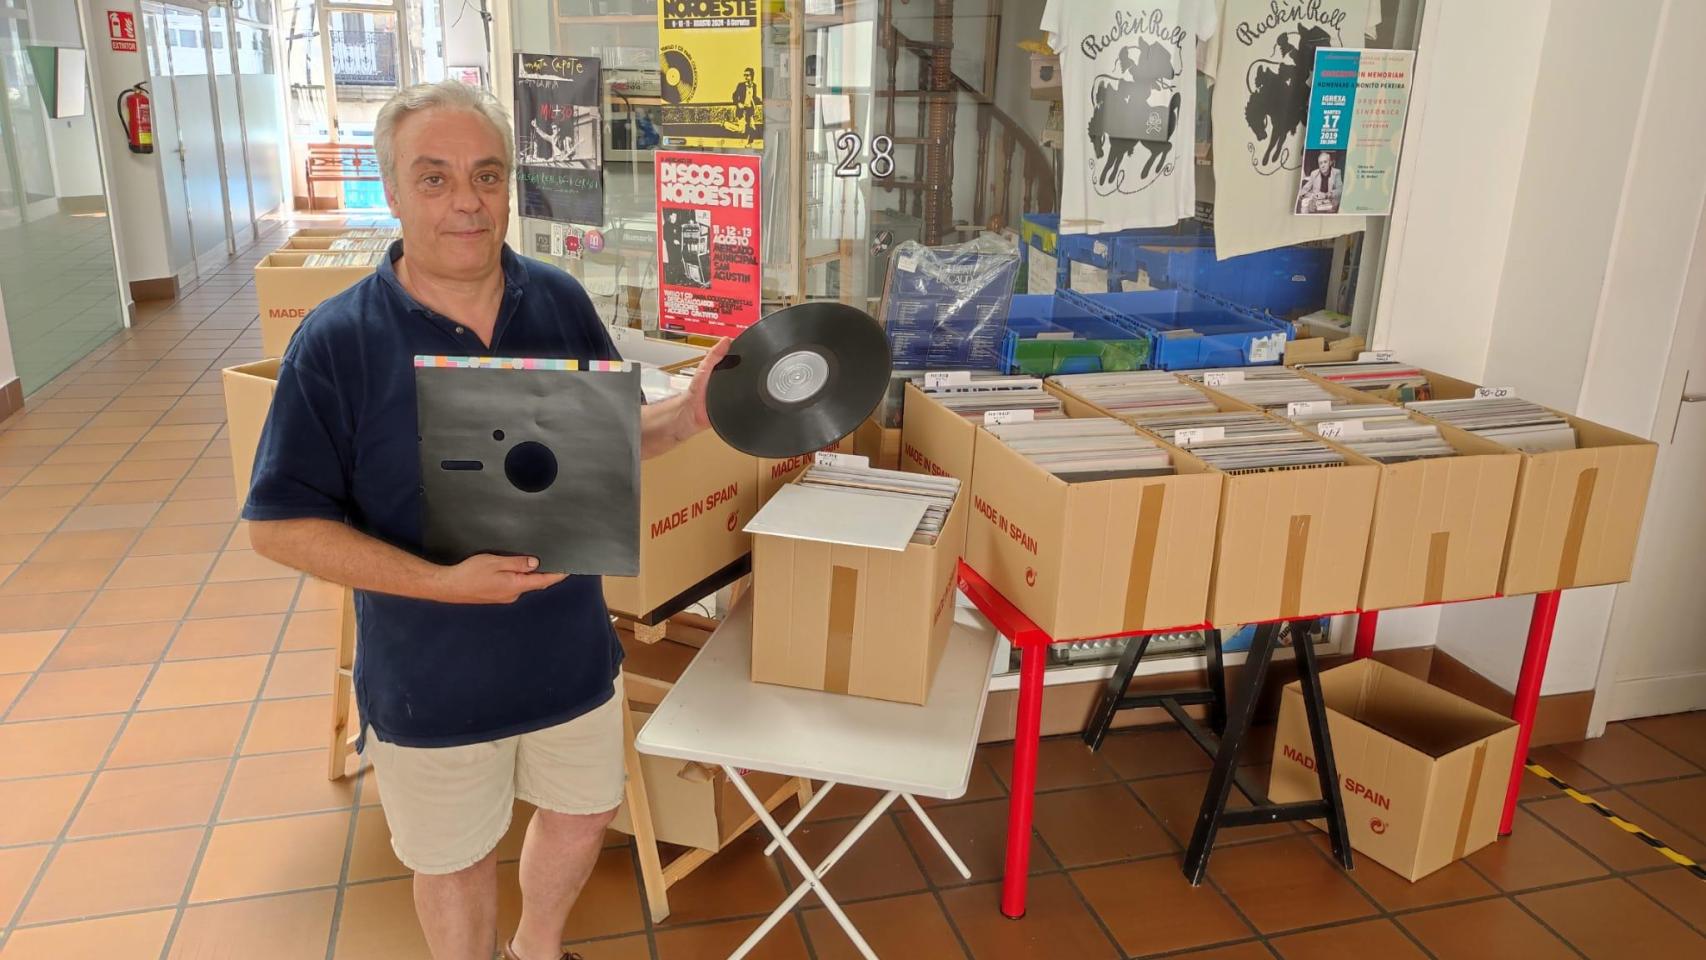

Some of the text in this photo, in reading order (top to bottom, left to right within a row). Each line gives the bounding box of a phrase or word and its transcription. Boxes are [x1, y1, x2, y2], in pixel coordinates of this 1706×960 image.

[1322, 115, 1341, 128] 17
[835, 131, 895, 178] 28
[661, 162, 755, 188] DISCOS DO
[661, 183, 754, 209] NOROESTE
[712, 234, 749, 247] AGOSTO
[269, 308, 305, 319] MADE
[905, 442, 923, 467] MADE
[771, 457, 800, 479] MADE
[651, 482, 739, 540] MADE IN SPAIN
[974, 494, 1038, 556] MADE IN SPAIN
[1344, 777, 1391, 811] SPAIN
